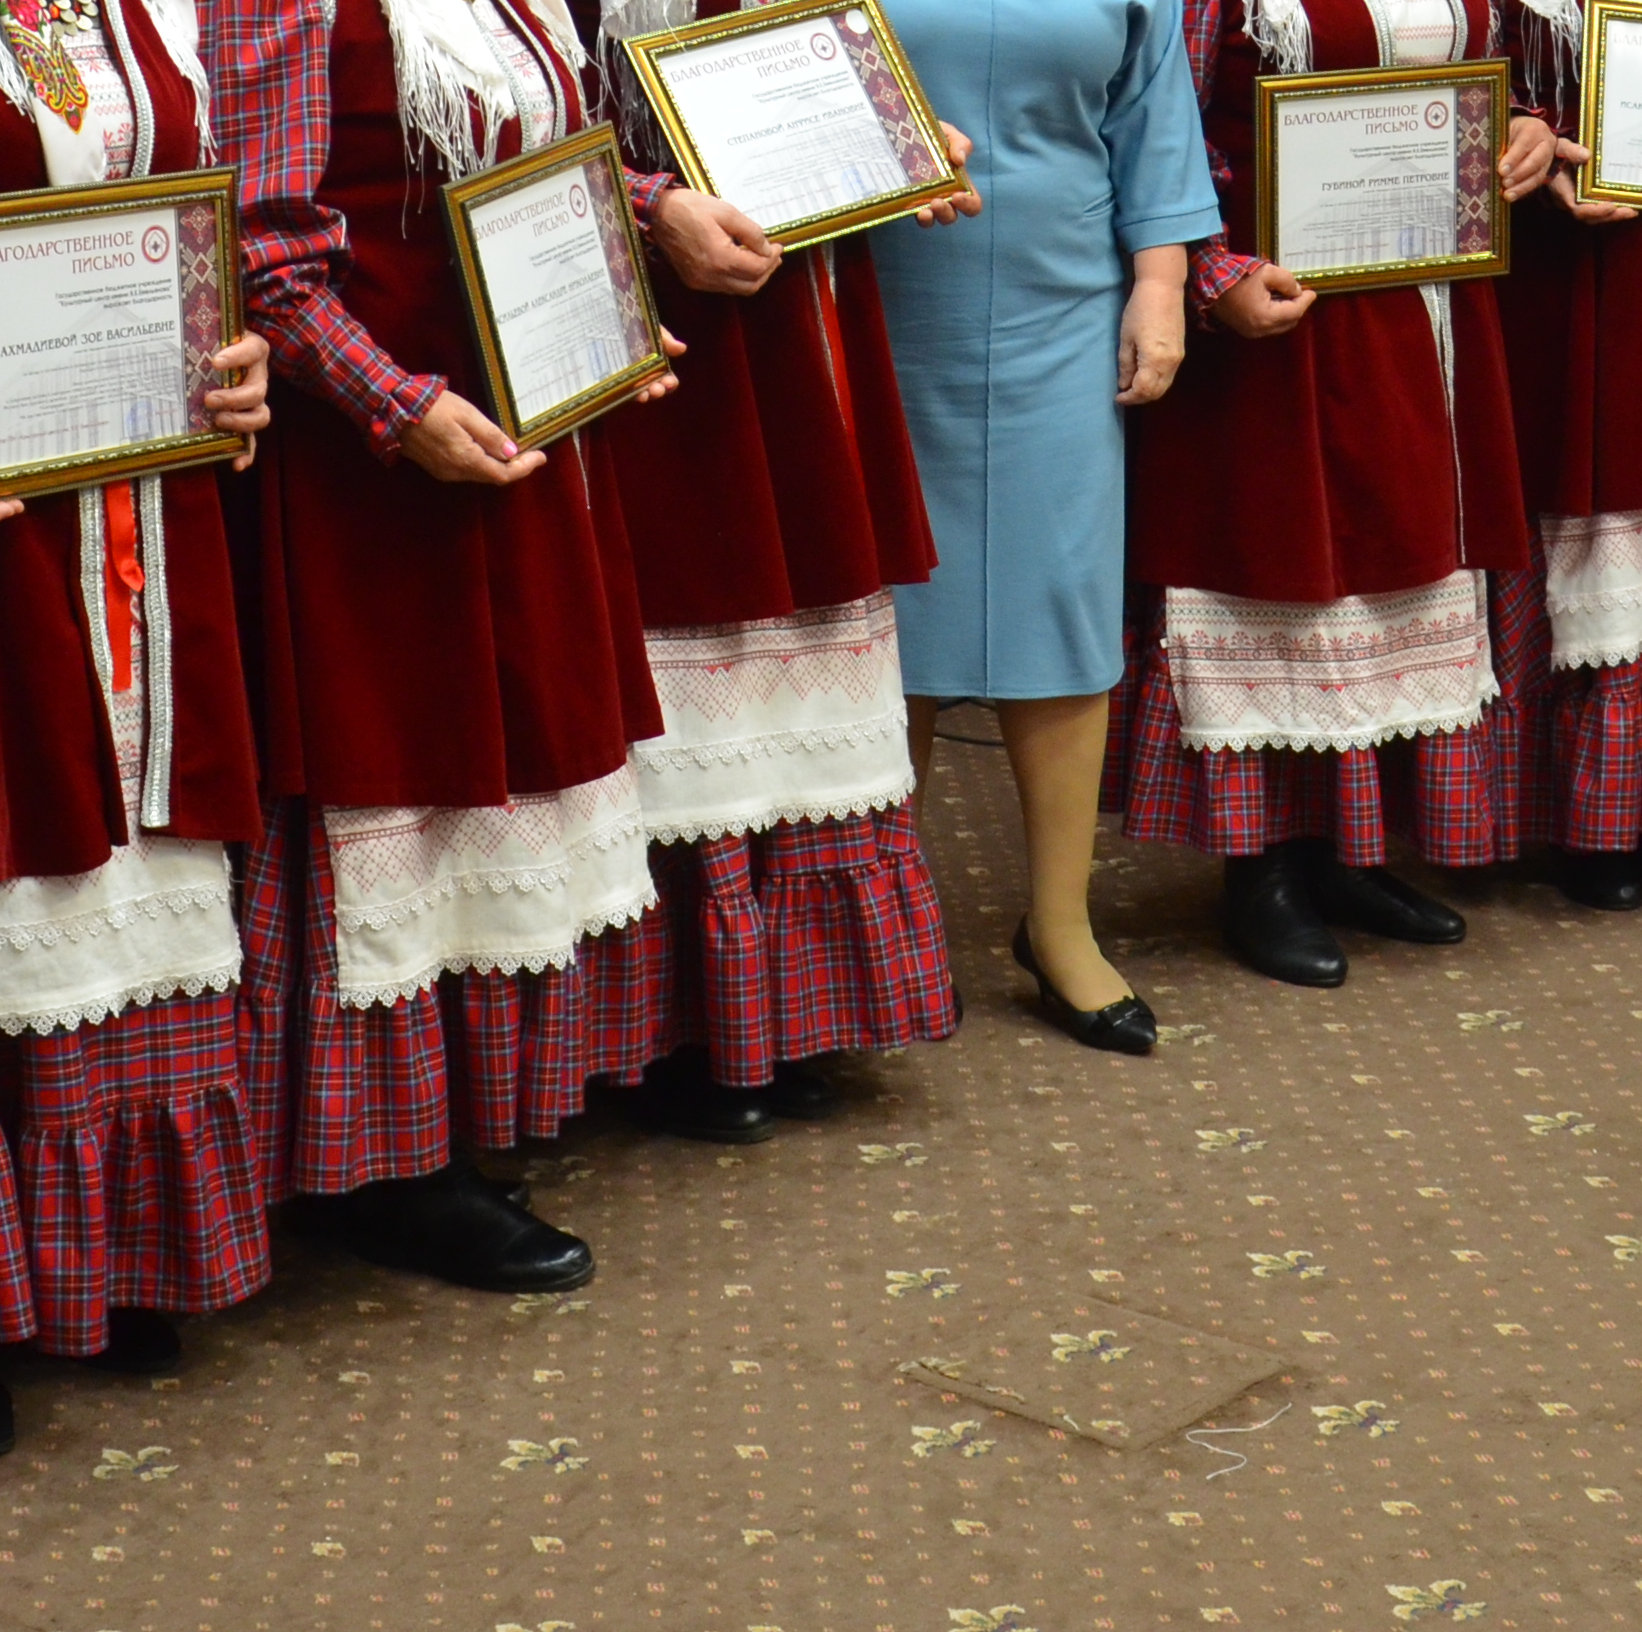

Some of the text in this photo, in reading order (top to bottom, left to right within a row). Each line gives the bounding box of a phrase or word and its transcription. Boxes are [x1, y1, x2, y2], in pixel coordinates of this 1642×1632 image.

[670, 39, 804, 84] БЛАГОДАРСТВЕННОЕ
[757, 55, 811, 79] ПИСЬМО
[1284, 104, 1418, 126] БЛАГОДАРСТВЕННОЕ
[1365, 120, 1419, 135] ПИСЬМО
[1322, 172, 1450, 191] ГУБИНОЙ РИММЕ ПЕТРОВНЕ
[532, 211, 570, 237] ПИСЬМО
[72, 252, 135, 274] ПИСЬМО
[0, 320, 175, 358] АХМАДИЕВОЙ ЗОЕ ВАСИЛЬЕВНЕ
